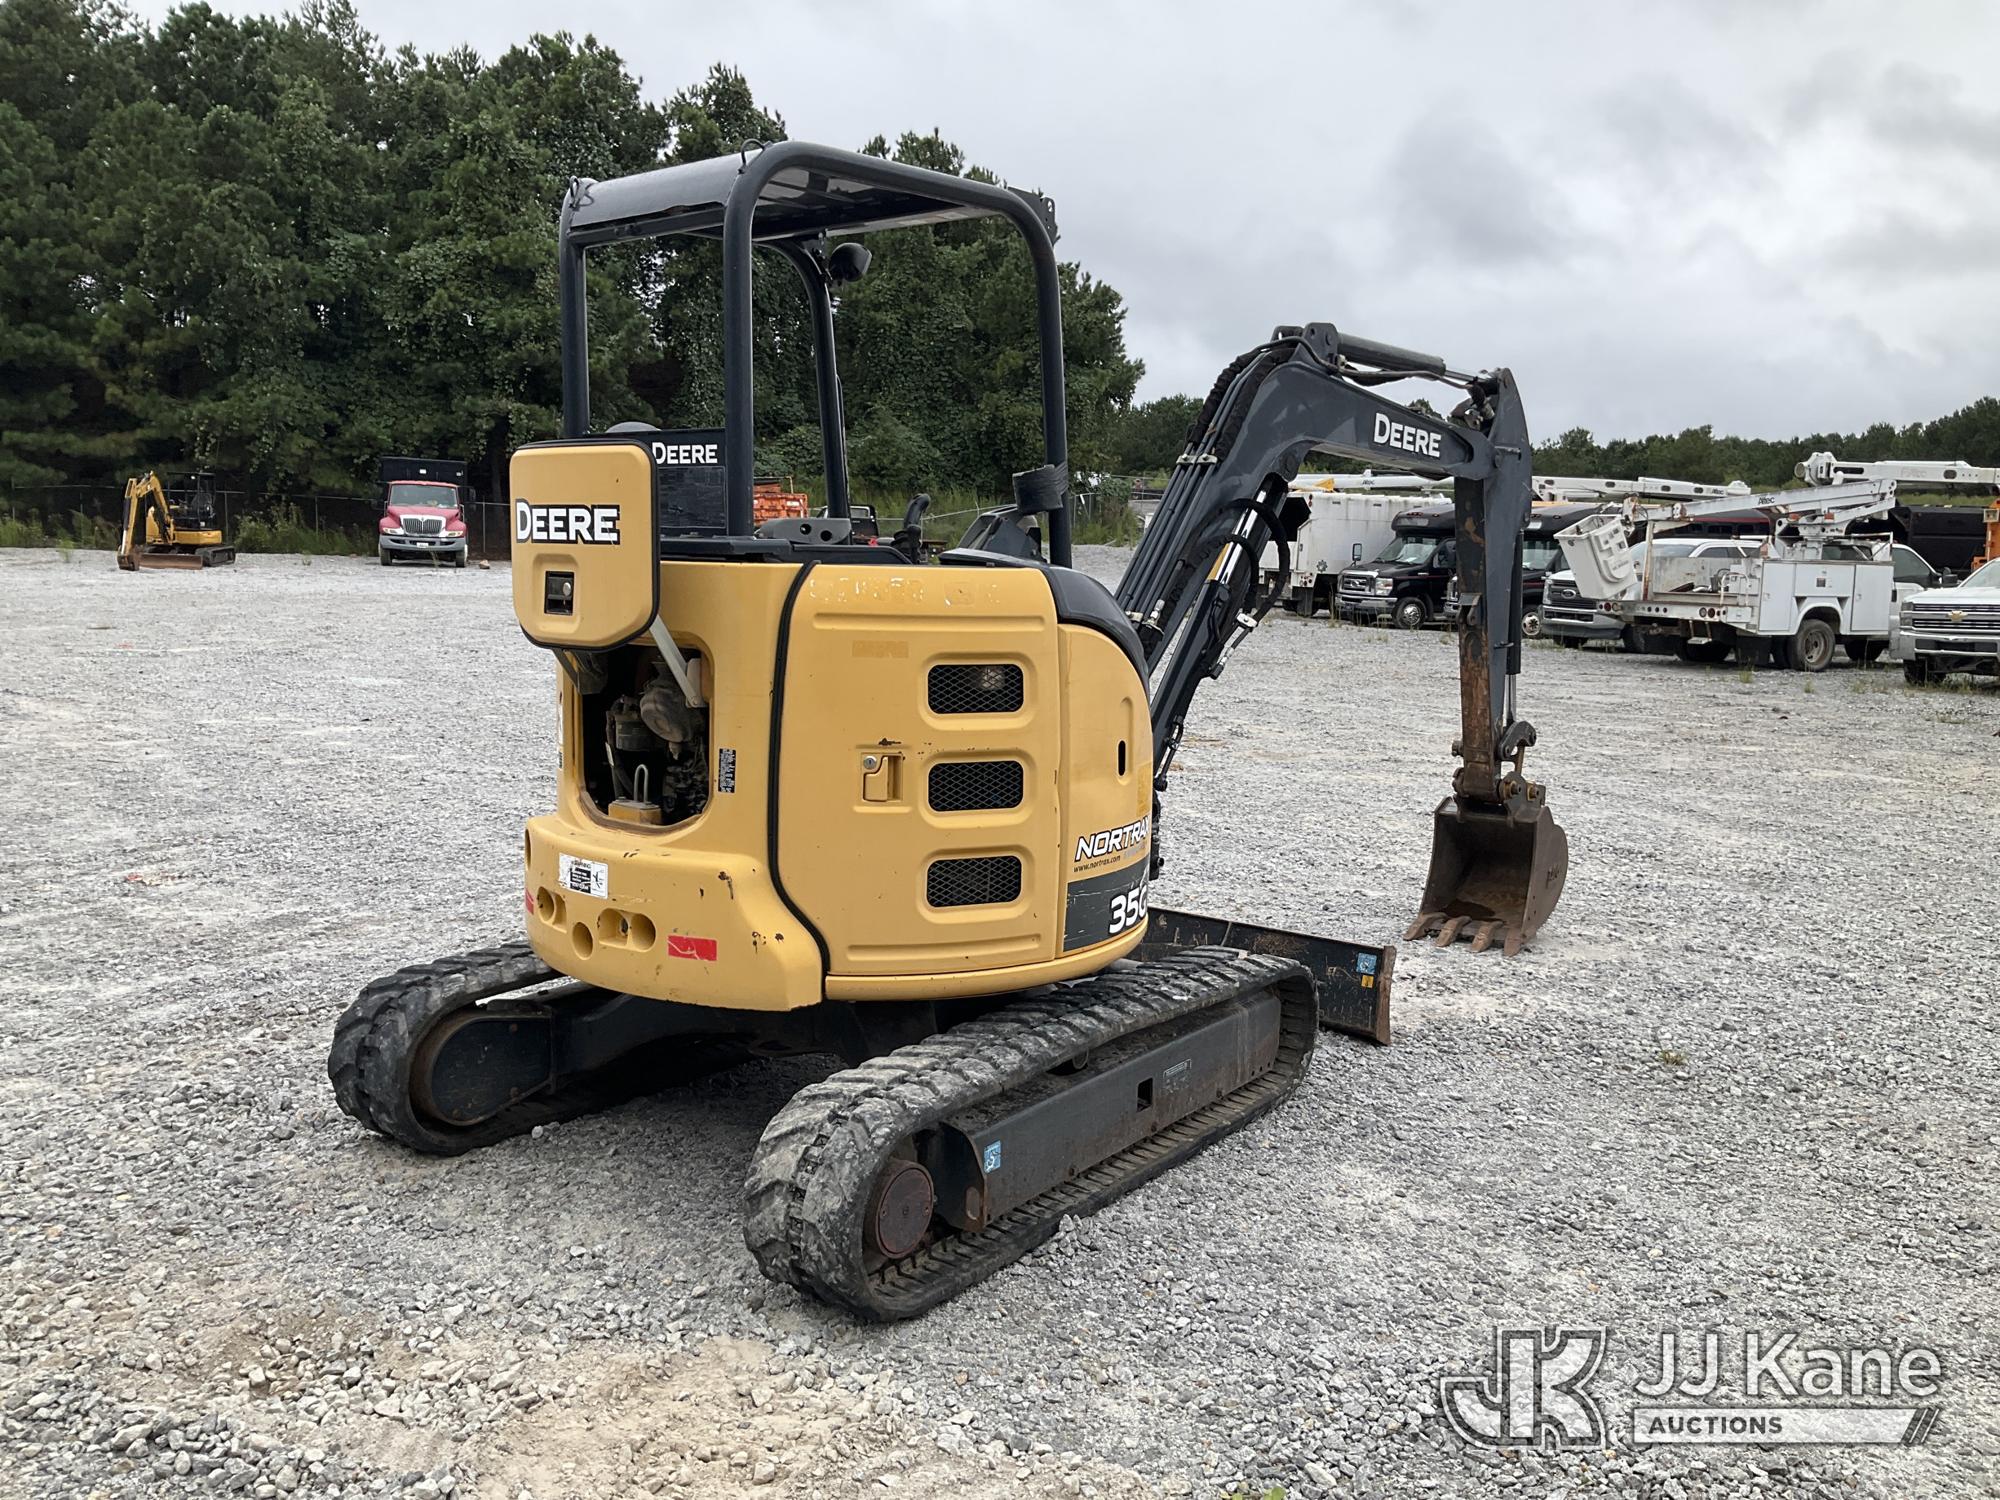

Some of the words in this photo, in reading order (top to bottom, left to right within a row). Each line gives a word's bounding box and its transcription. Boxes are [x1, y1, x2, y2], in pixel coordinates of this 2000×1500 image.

[652, 441, 718, 465] DEERE
[1373, 412, 1441, 458] DEERE
[515, 500, 620, 543] DEERE
